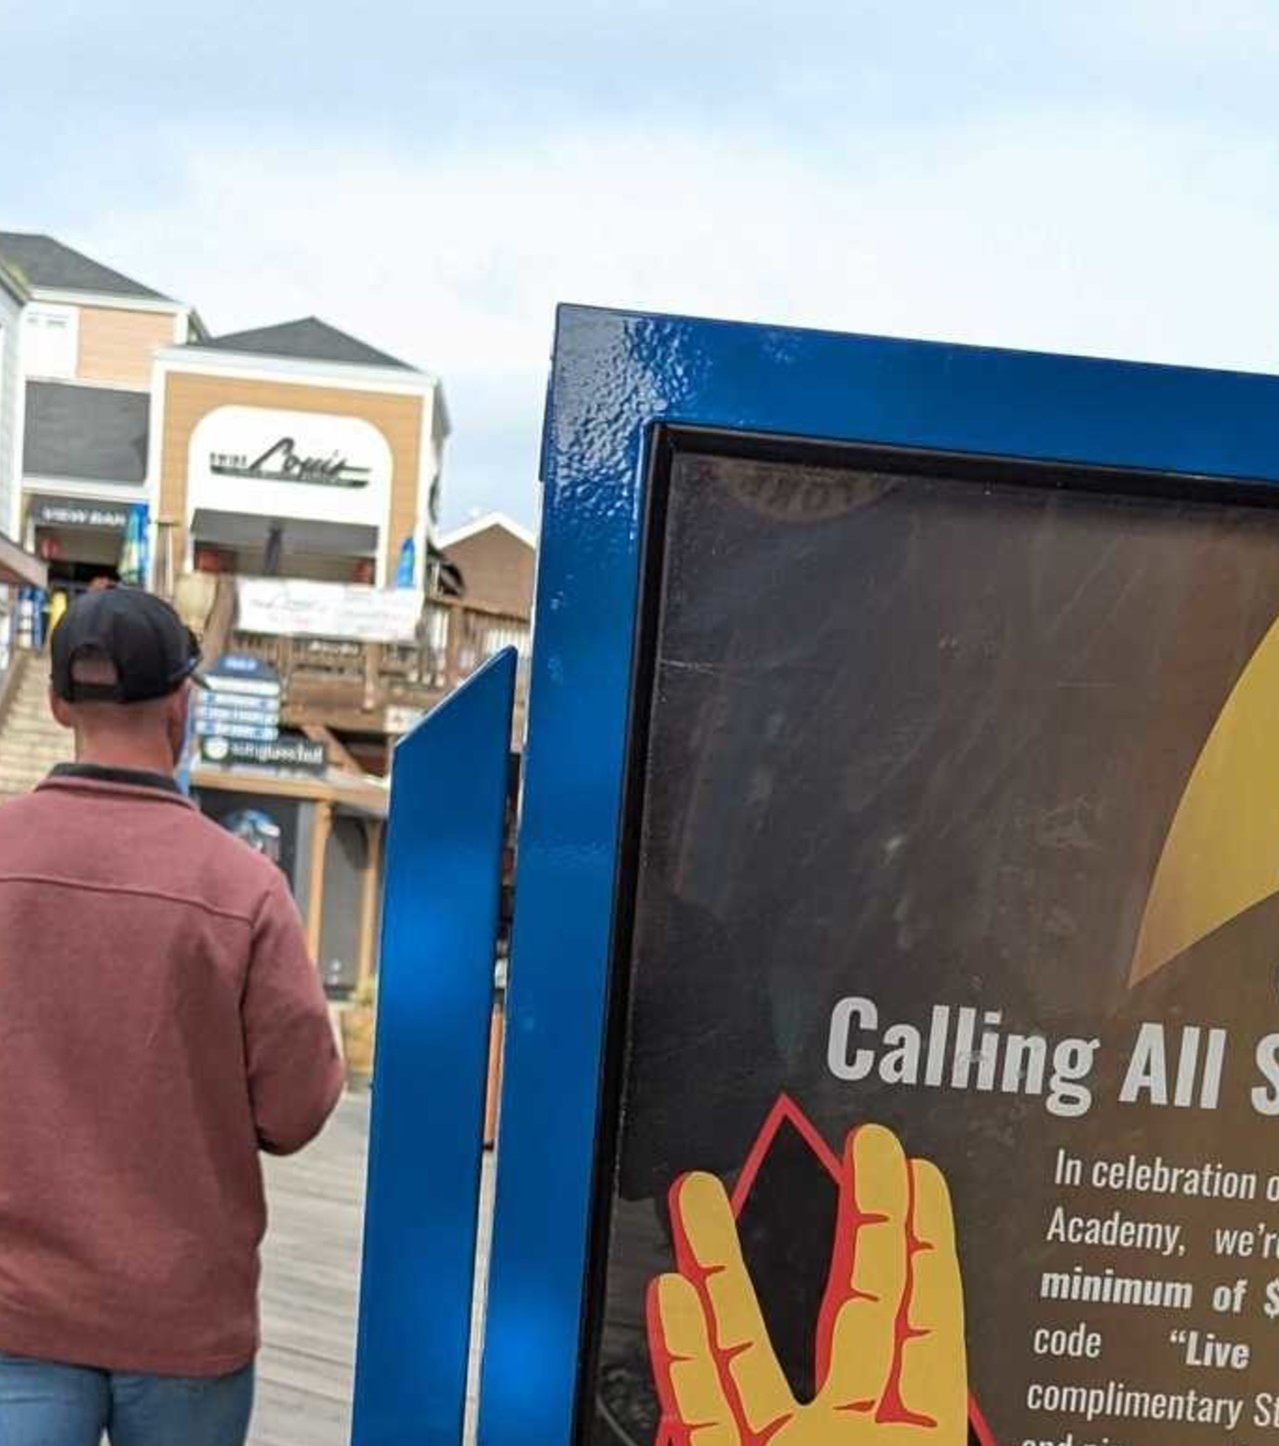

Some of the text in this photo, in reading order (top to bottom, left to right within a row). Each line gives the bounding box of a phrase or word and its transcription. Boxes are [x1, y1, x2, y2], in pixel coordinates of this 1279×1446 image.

[827, 996, 1101, 1118] Calling
[1118, 1021, 1227, 1110] All
[1055, 1148, 1082, 1185] In
[1092, 1155, 1256, 1199] celebration
[1046, 1206, 1185, 1256] Academy,
[1040, 1266, 1193, 1309] minimum
[1212, 1280, 1248, 1313] of
[1034, 1323, 1101, 1358] code
[1027, 1381, 1243, 1430] complimentary
